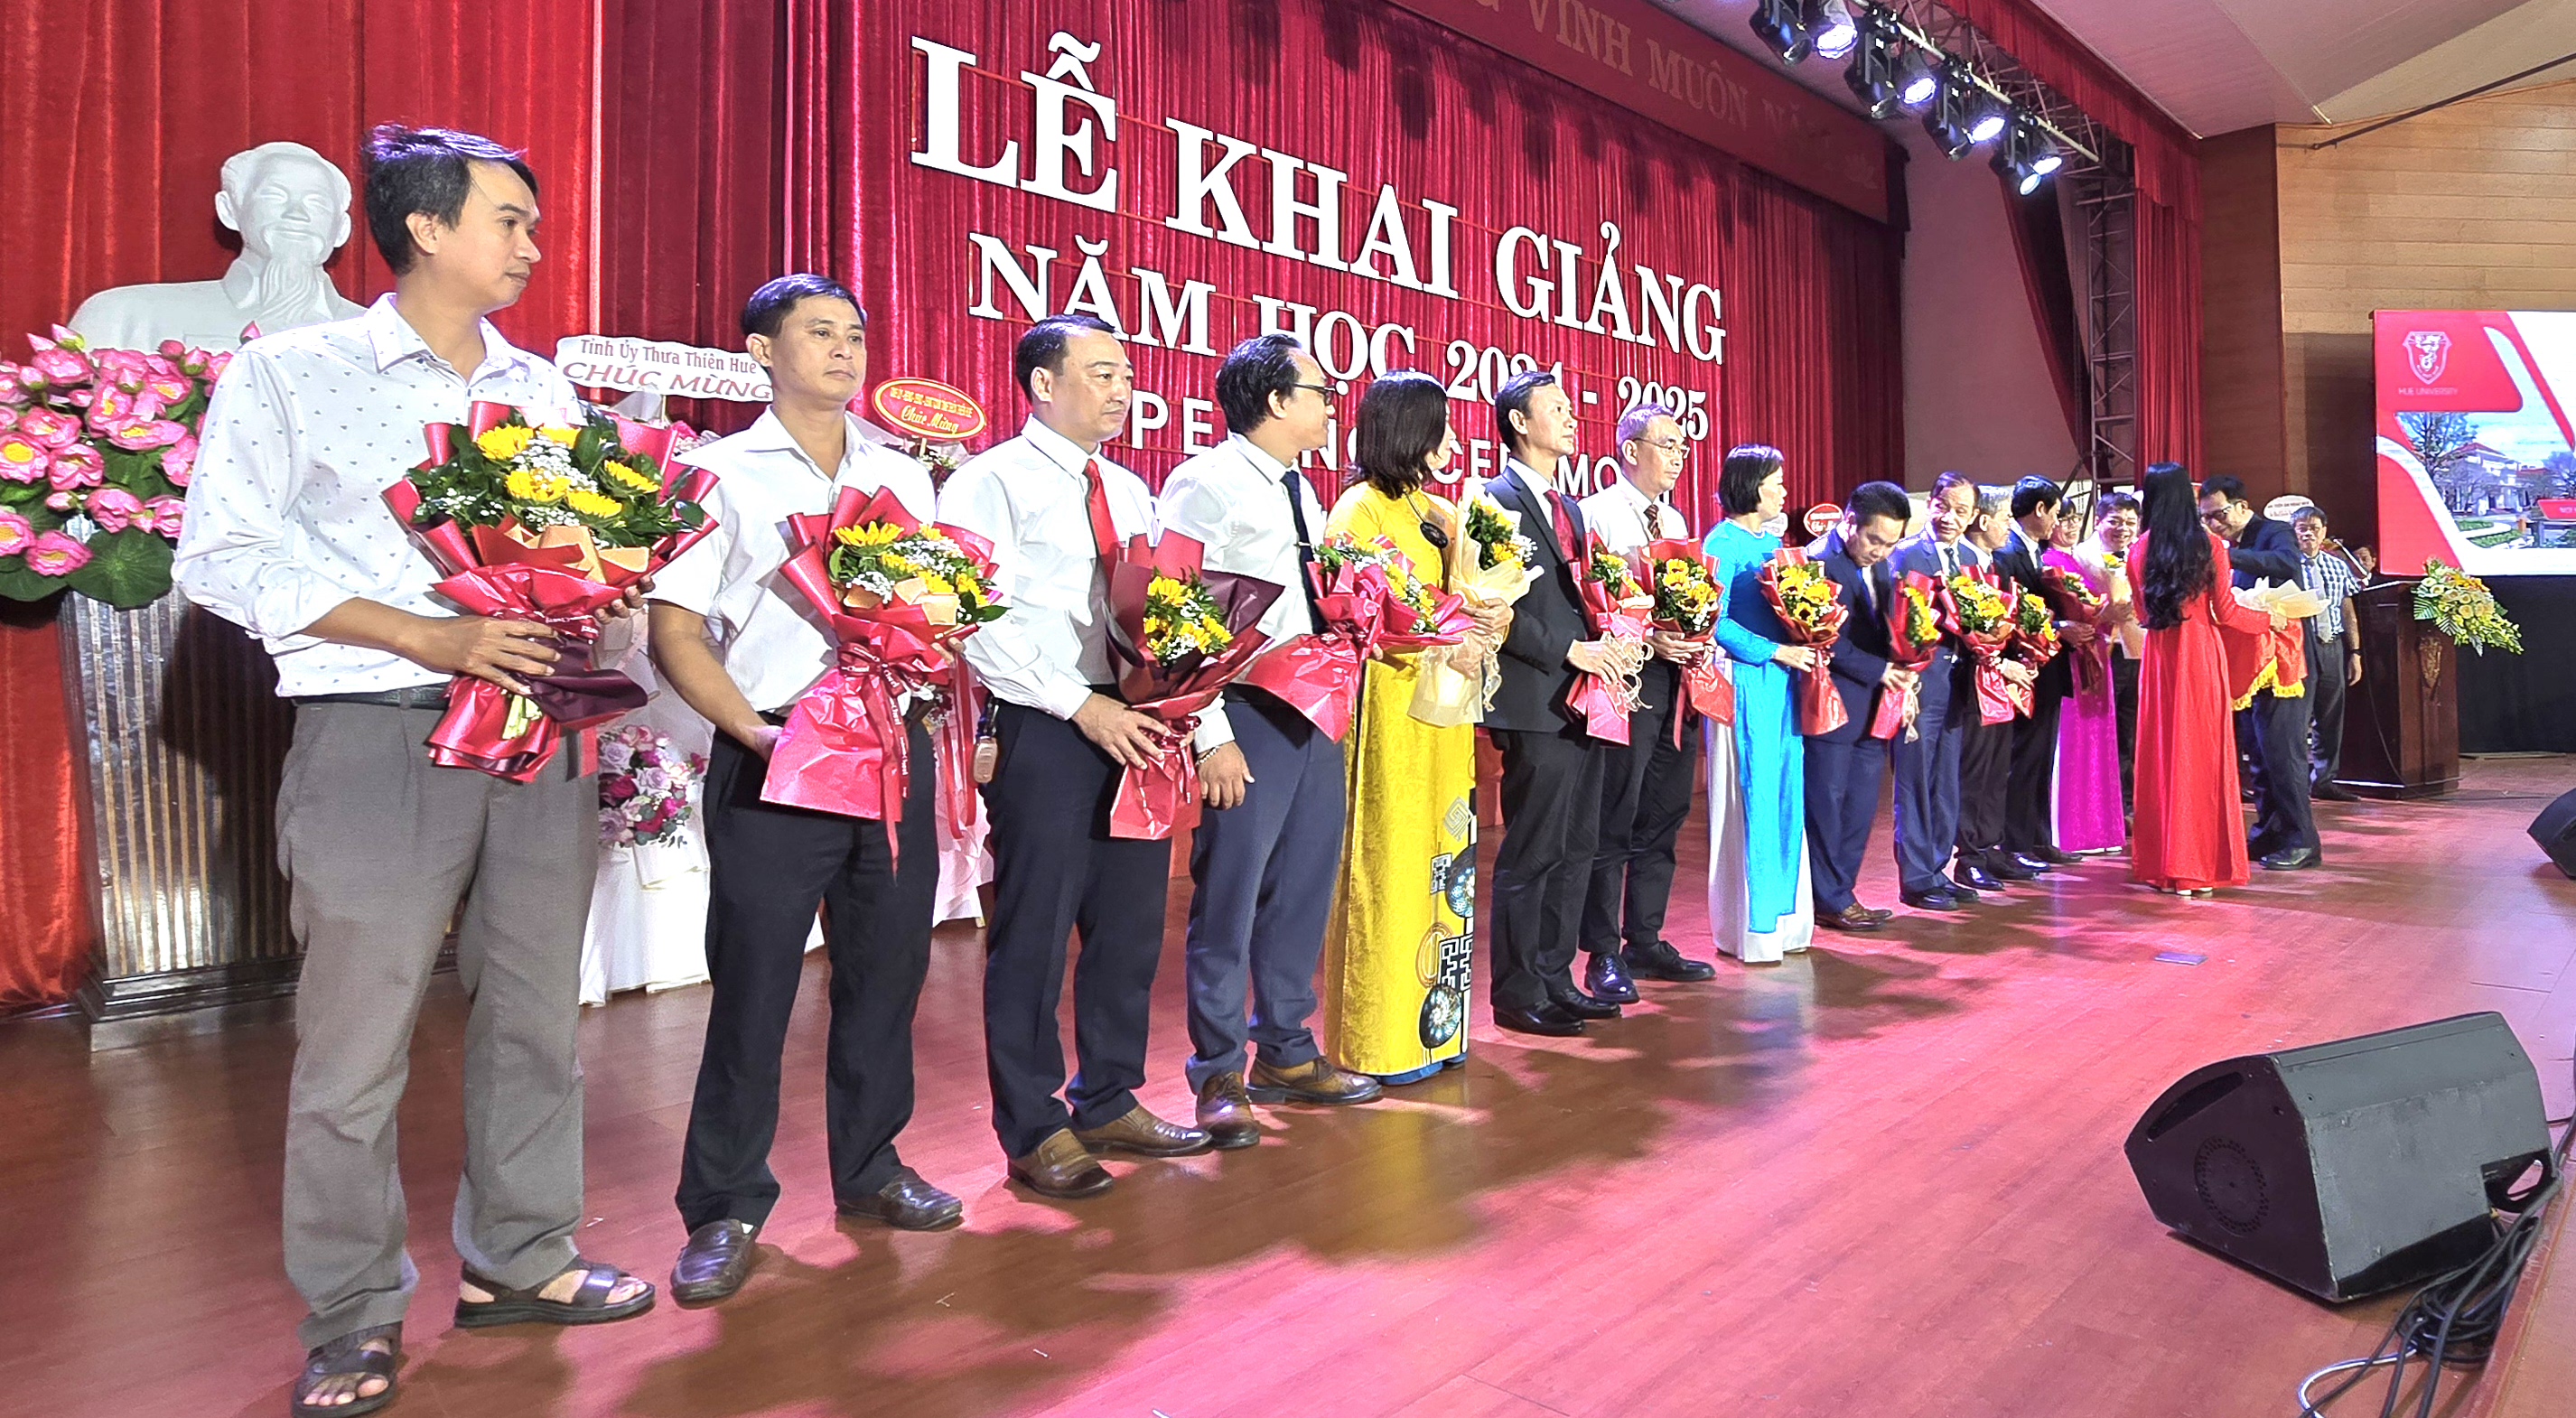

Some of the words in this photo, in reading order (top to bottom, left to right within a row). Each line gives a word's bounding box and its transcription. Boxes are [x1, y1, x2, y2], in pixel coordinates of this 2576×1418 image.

[1647, 37, 1749, 132] MUÔN
[910, 31, 1117, 213] LỄ
[1165, 117, 1459, 300] KHAI
[1496, 221, 1726, 365] GIẢNG
[581, 338, 614, 357] Tỉnh
[685, 352, 724, 370] Thiên
[969, 232, 1216, 356] NĂM
[1253, 294, 1414, 396] HỌC
[563, 362, 661, 387] CHÚC
[669, 374, 771, 398] MỪNG
